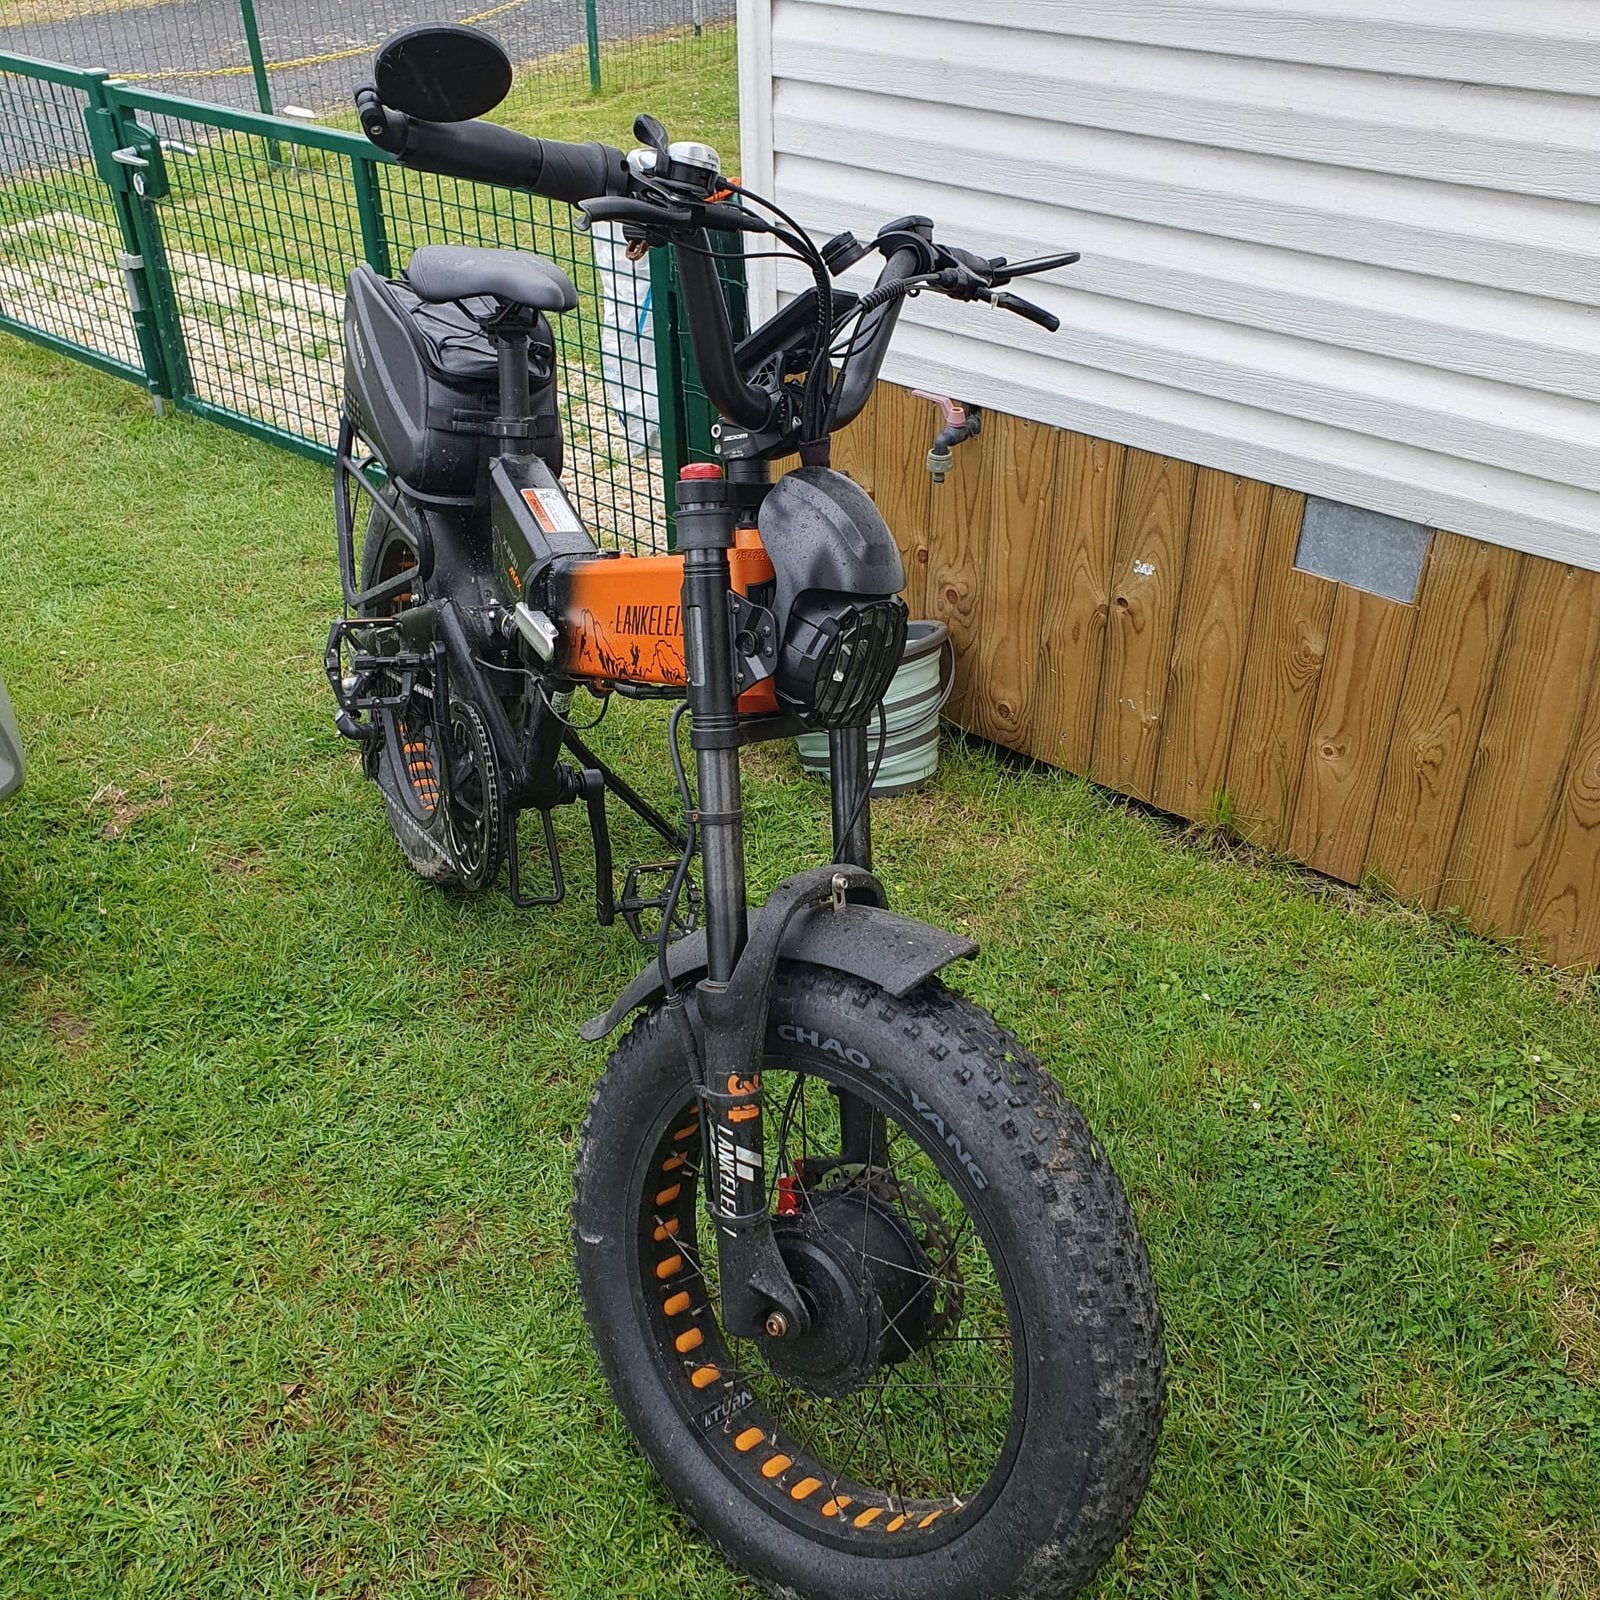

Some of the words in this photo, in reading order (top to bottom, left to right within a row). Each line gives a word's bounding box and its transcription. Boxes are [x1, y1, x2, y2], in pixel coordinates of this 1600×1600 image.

[615, 604, 684, 637] LANKELEI
[777, 1024, 871, 1070] CHAO
[910, 1088, 989, 1191] YANG
[717, 1123, 738, 1239] LANKELEII
